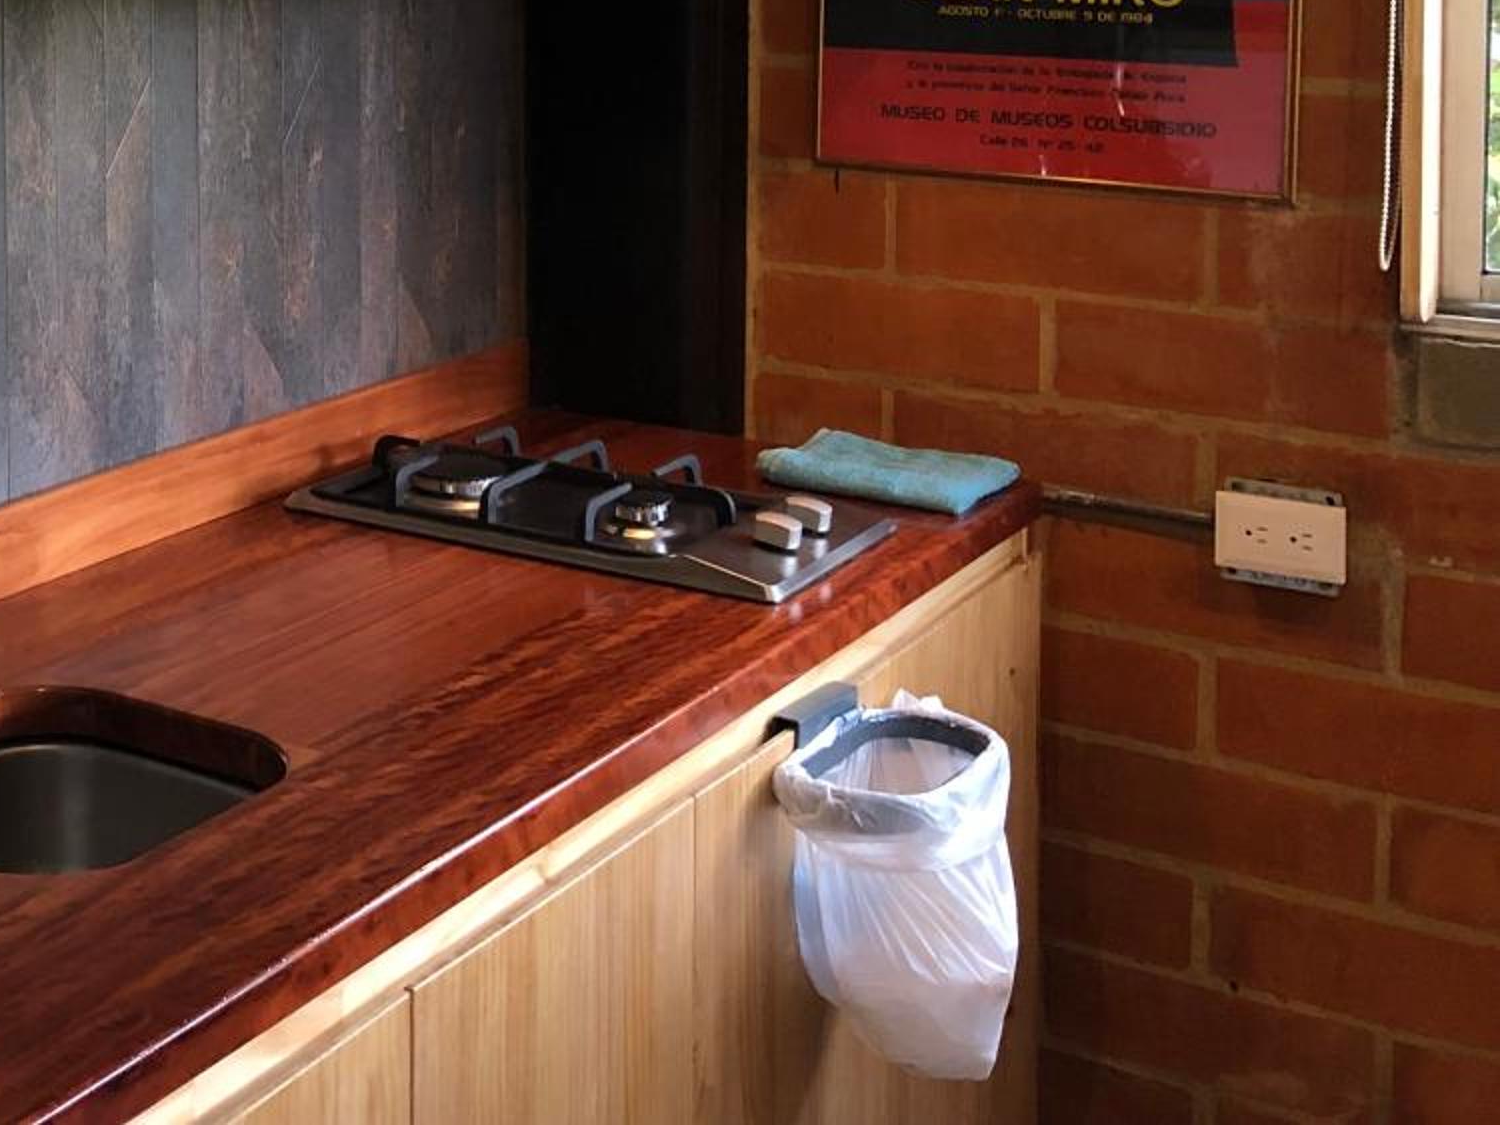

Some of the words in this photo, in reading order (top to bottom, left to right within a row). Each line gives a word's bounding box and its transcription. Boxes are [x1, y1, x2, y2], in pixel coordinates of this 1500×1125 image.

[938, 5, 989, 17] AGOSTO
[1017, 8, 1077, 21] OCTUBRE
[1097, 11, 1116, 23] DE
[881, 103, 946, 122] MUSEO
[955, 107, 981, 124] DE
[991, 110, 1074, 129] MUSEOS
[1083, 115, 1218, 139] COLSUBSIDIO
